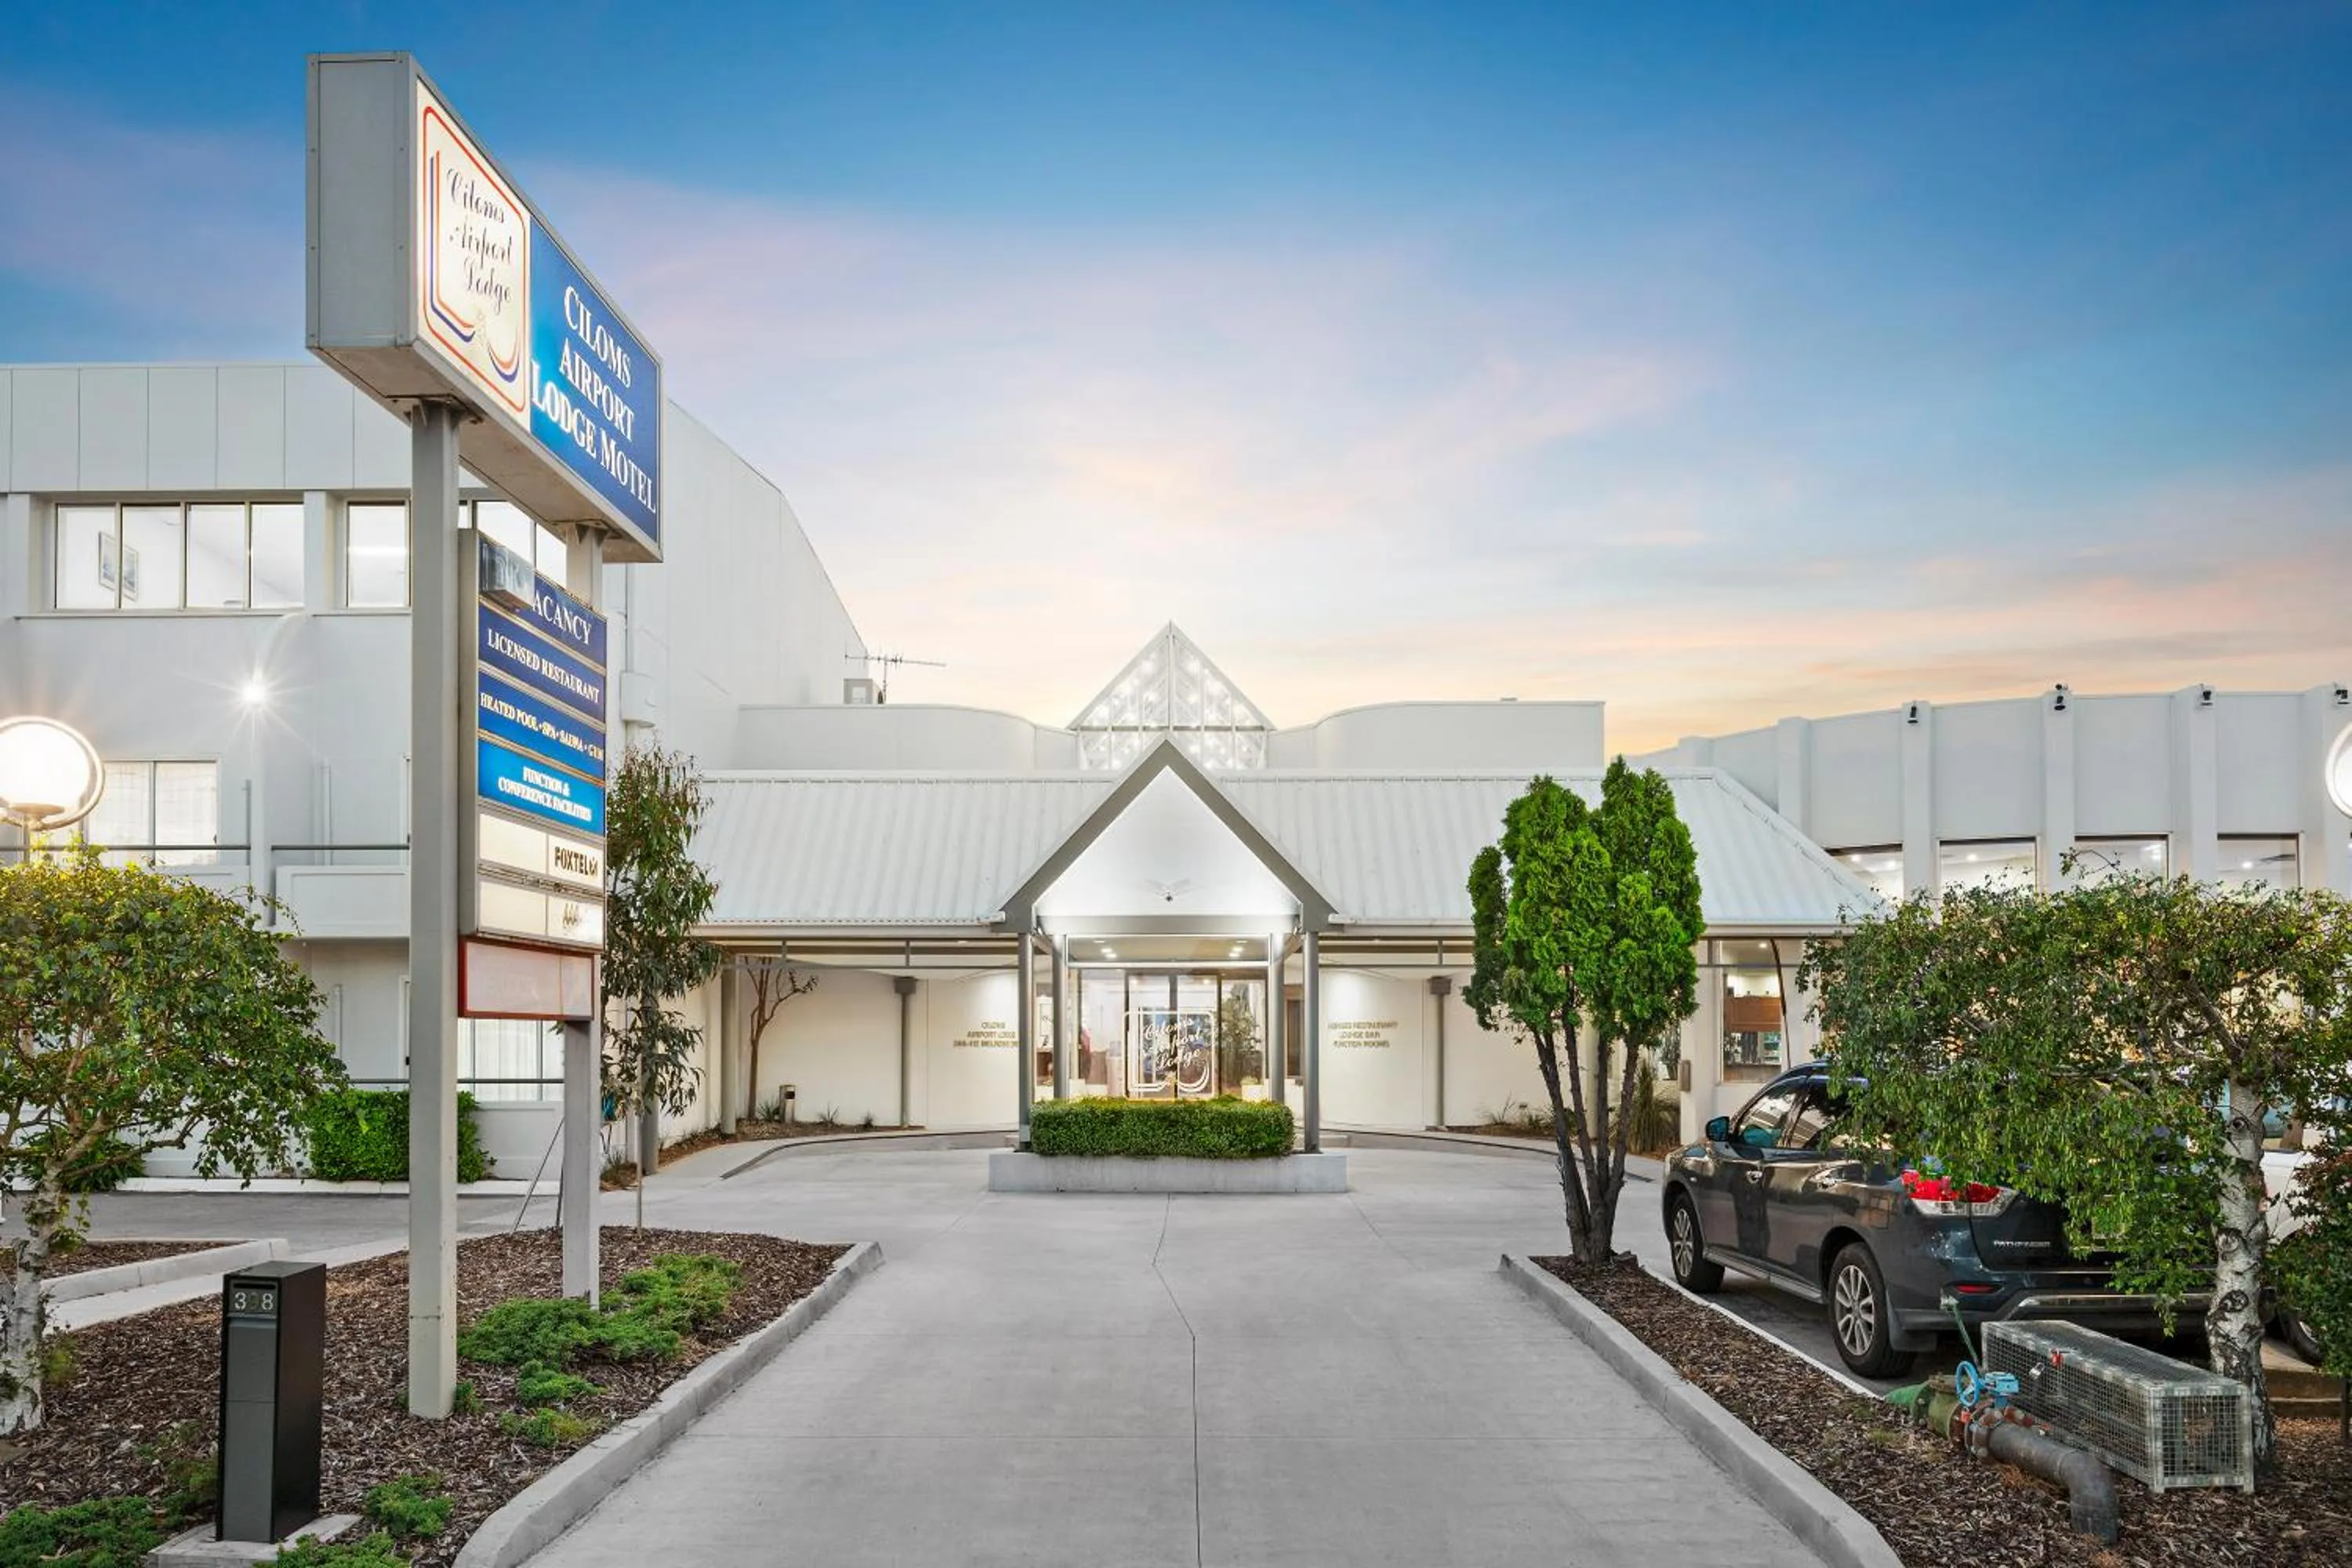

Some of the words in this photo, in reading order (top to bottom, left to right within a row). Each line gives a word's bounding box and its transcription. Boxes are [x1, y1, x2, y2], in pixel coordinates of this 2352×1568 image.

[447, 168, 505, 224] Ciloms
[463, 256, 512, 316] Lodge
[564, 285, 632, 388] CILOMS
[559, 337, 634, 443] AIRPORT
[531, 358, 597, 460] LODGE
[601, 427, 656, 514] MOTEL
[532, 589, 593, 645] ACANCY
[488, 628, 540, 671] LICENSED
[542, 658, 600, 703] RESTAURANT
[480, 692, 516, 720] HEATED
[516, 709, 539, 731] POOL
[554, 846, 589, 876] FOXTEL
